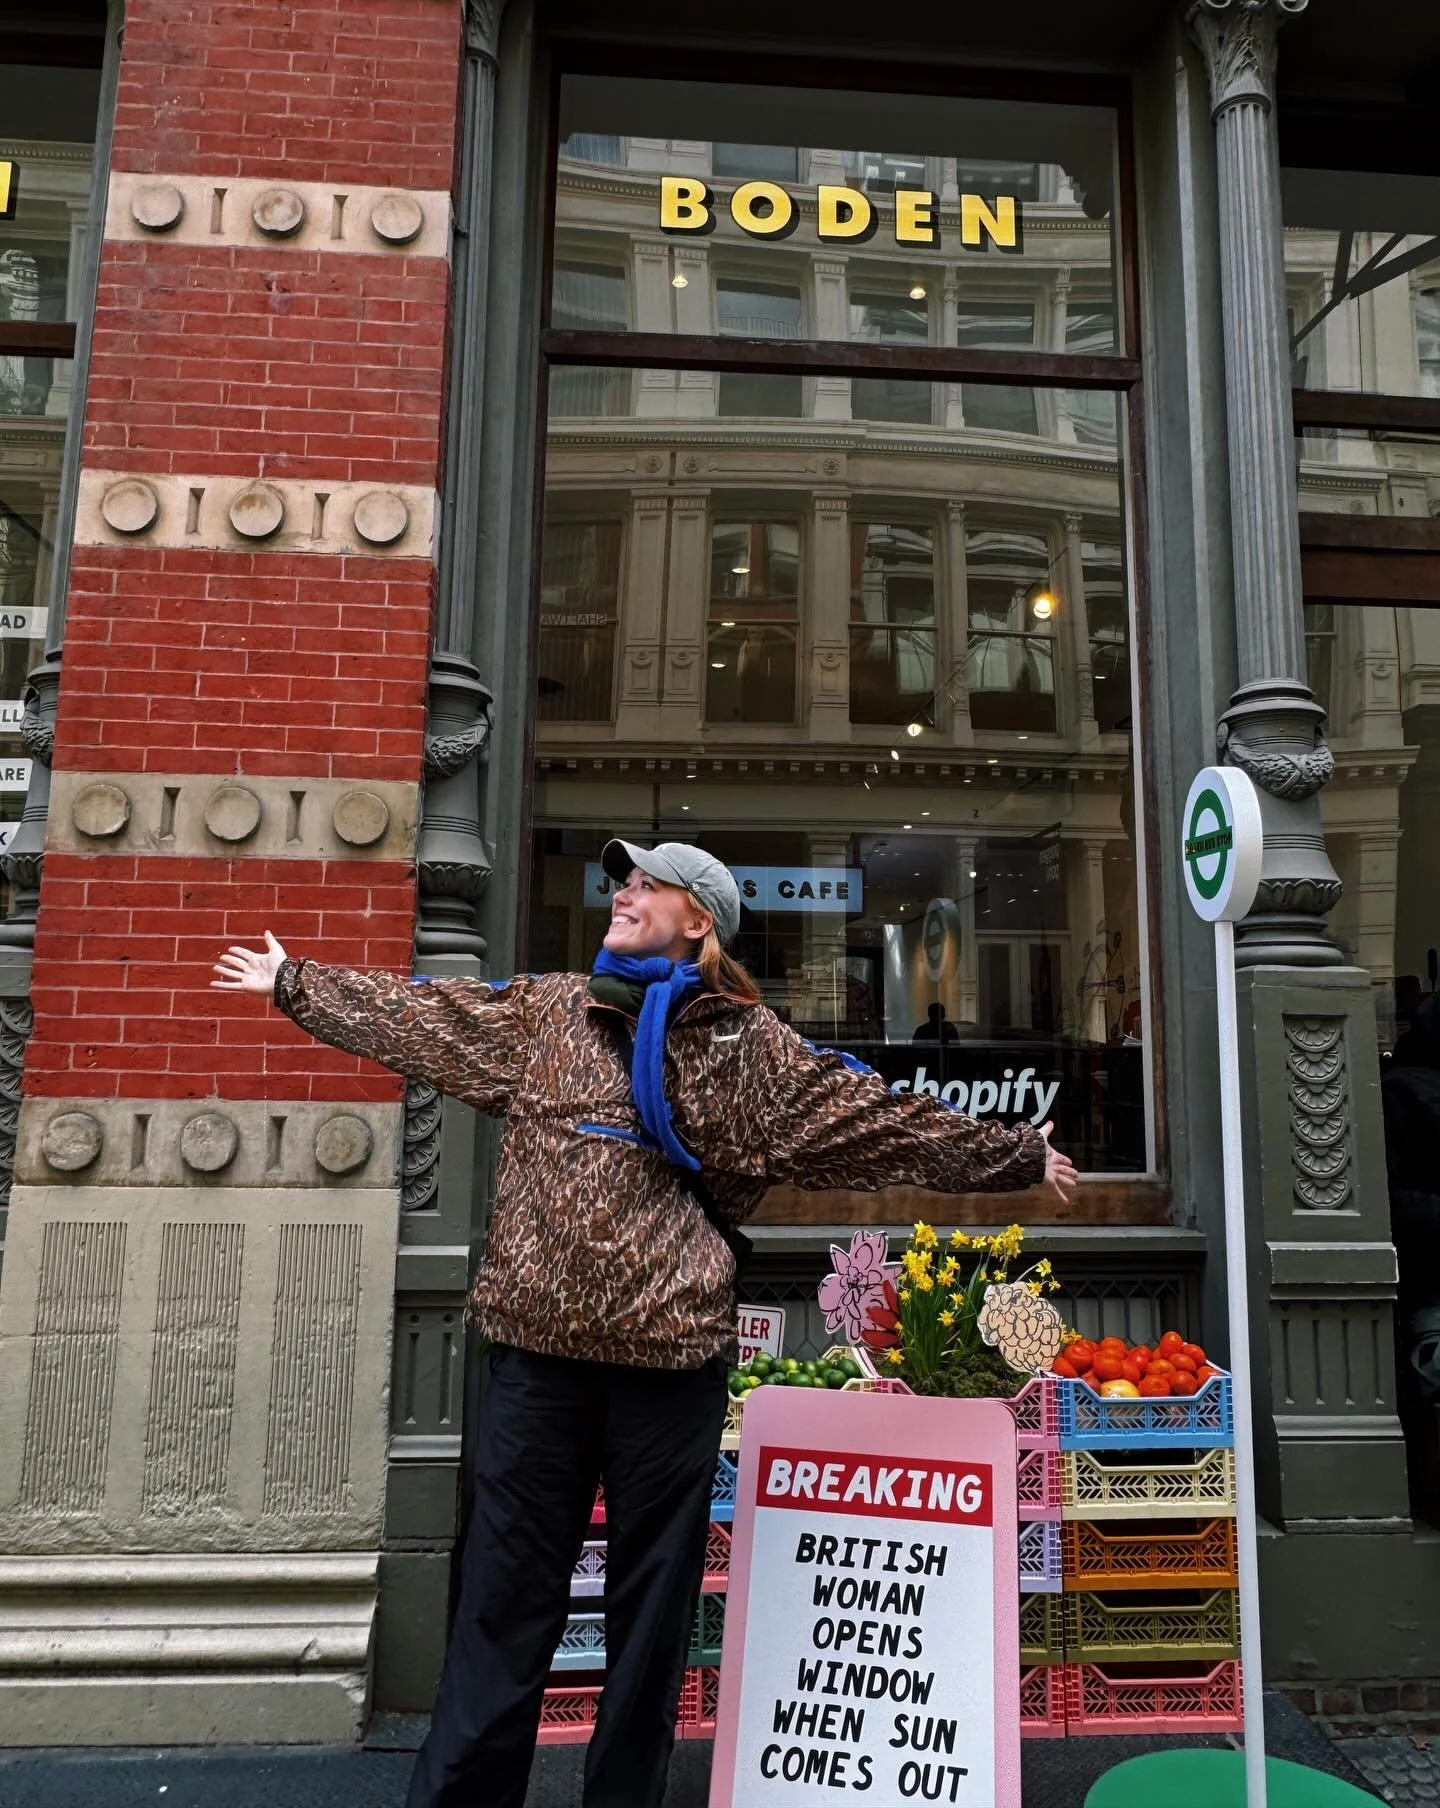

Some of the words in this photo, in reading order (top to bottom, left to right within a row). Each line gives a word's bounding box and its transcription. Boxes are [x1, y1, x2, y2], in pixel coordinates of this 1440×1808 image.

[660, 176, 1022, 252] BODEN
[0, 614, 26, 629] AD
[777, 880, 849, 900] CAFE
[737, 1315, 770, 1340] LER
[765, 1458, 983, 1513] BREAKING
[795, 1533, 948, 1577] BRITISH
[812, 1574, 925, 1616] WOMAN
[812, 1617, 923, 1660] OPENS
[797, 1658, 935, 1705] WINDOW
[772, 1699, 865, 1743] WHEN
[888, 1713, 957, 1754] SUN
[760, 1743, 873, 1791] COMES
[898, 1760, 968, 1803] OUT
